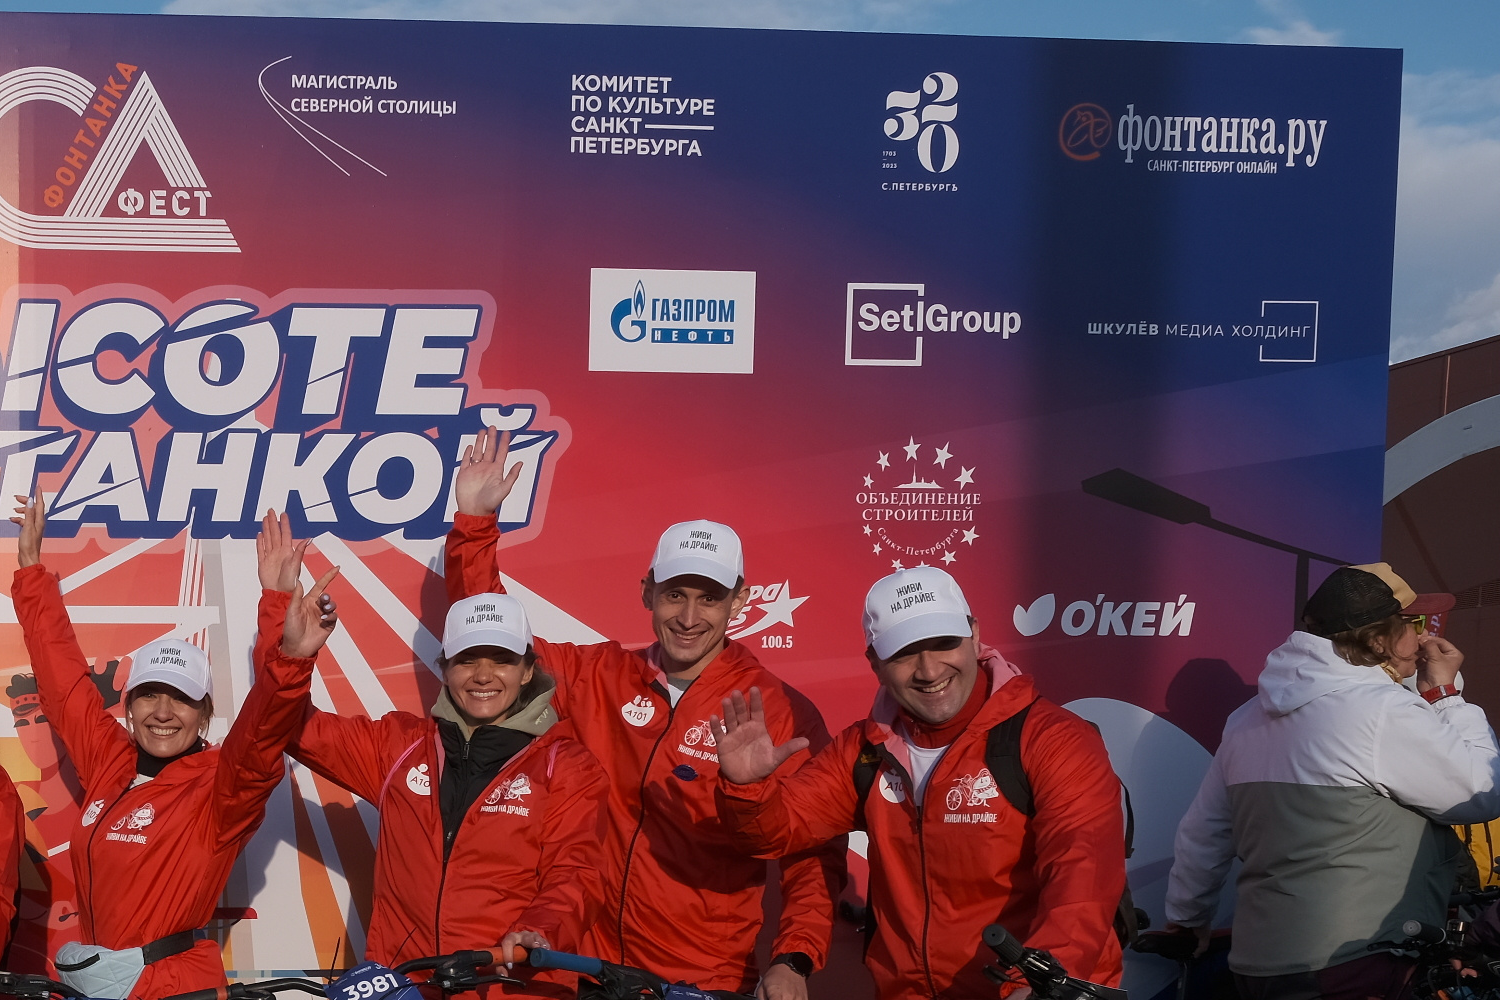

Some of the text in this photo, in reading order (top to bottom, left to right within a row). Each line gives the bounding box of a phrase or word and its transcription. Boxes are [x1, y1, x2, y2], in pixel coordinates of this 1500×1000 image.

[291, 74, 398, 90] МАГИСТРАЛЬ
[571, 74, 672, 94] КОМИТЕТ
[291, 96, 457, 118] СЕВЕРНОЙ СТОЛИЦЫ
[571, 95, 715, 116] ПО КУЛЬТУРЕ
[43, 62, 138, 208] ФОНТАНКА
[1117, 104, 1328, 167] фонтанка.ру
[570, 136, 702, 157] ПЕТЕРБУРГА
[1147, 159, 1278, 175] САНКТ-ПЕТЕРБУРГ ОНЛАЙН
[117, 188, 213, 217] ФЕСТ
[651, 298, 735, 322] ГАЗПРОМ
[654, 330, 731, 342] НЕФТЬ
[1087, 321, 1311, 339] ШКУЛЁВ МЕДИА ХОЛДИНГ
[855, 492, 982, 507] ОБЪЕДИНЕНИЕ
[862, 506, 974, 521] СТРОИТЕЛЕЙ
[689, 530, 713, 541] ЖИВИ
[877, 527, 959, 556] Санкт-Петербурга
[679, 540, 719, 553] НА ДРАЙВЕ
[896, 582, 923, 598] ЖИВИ
[474, 604, 496, 613] ЖИВИ
[890, 591, 937, 614] НА ДРАЙВЕ
[466, 612, 504, 625] НА ДРАЙВЕ
[761, 636, 794, 649] 100.5
[943, 812, 998, 824] ЖИВИ НА ДРАЙВЕ
